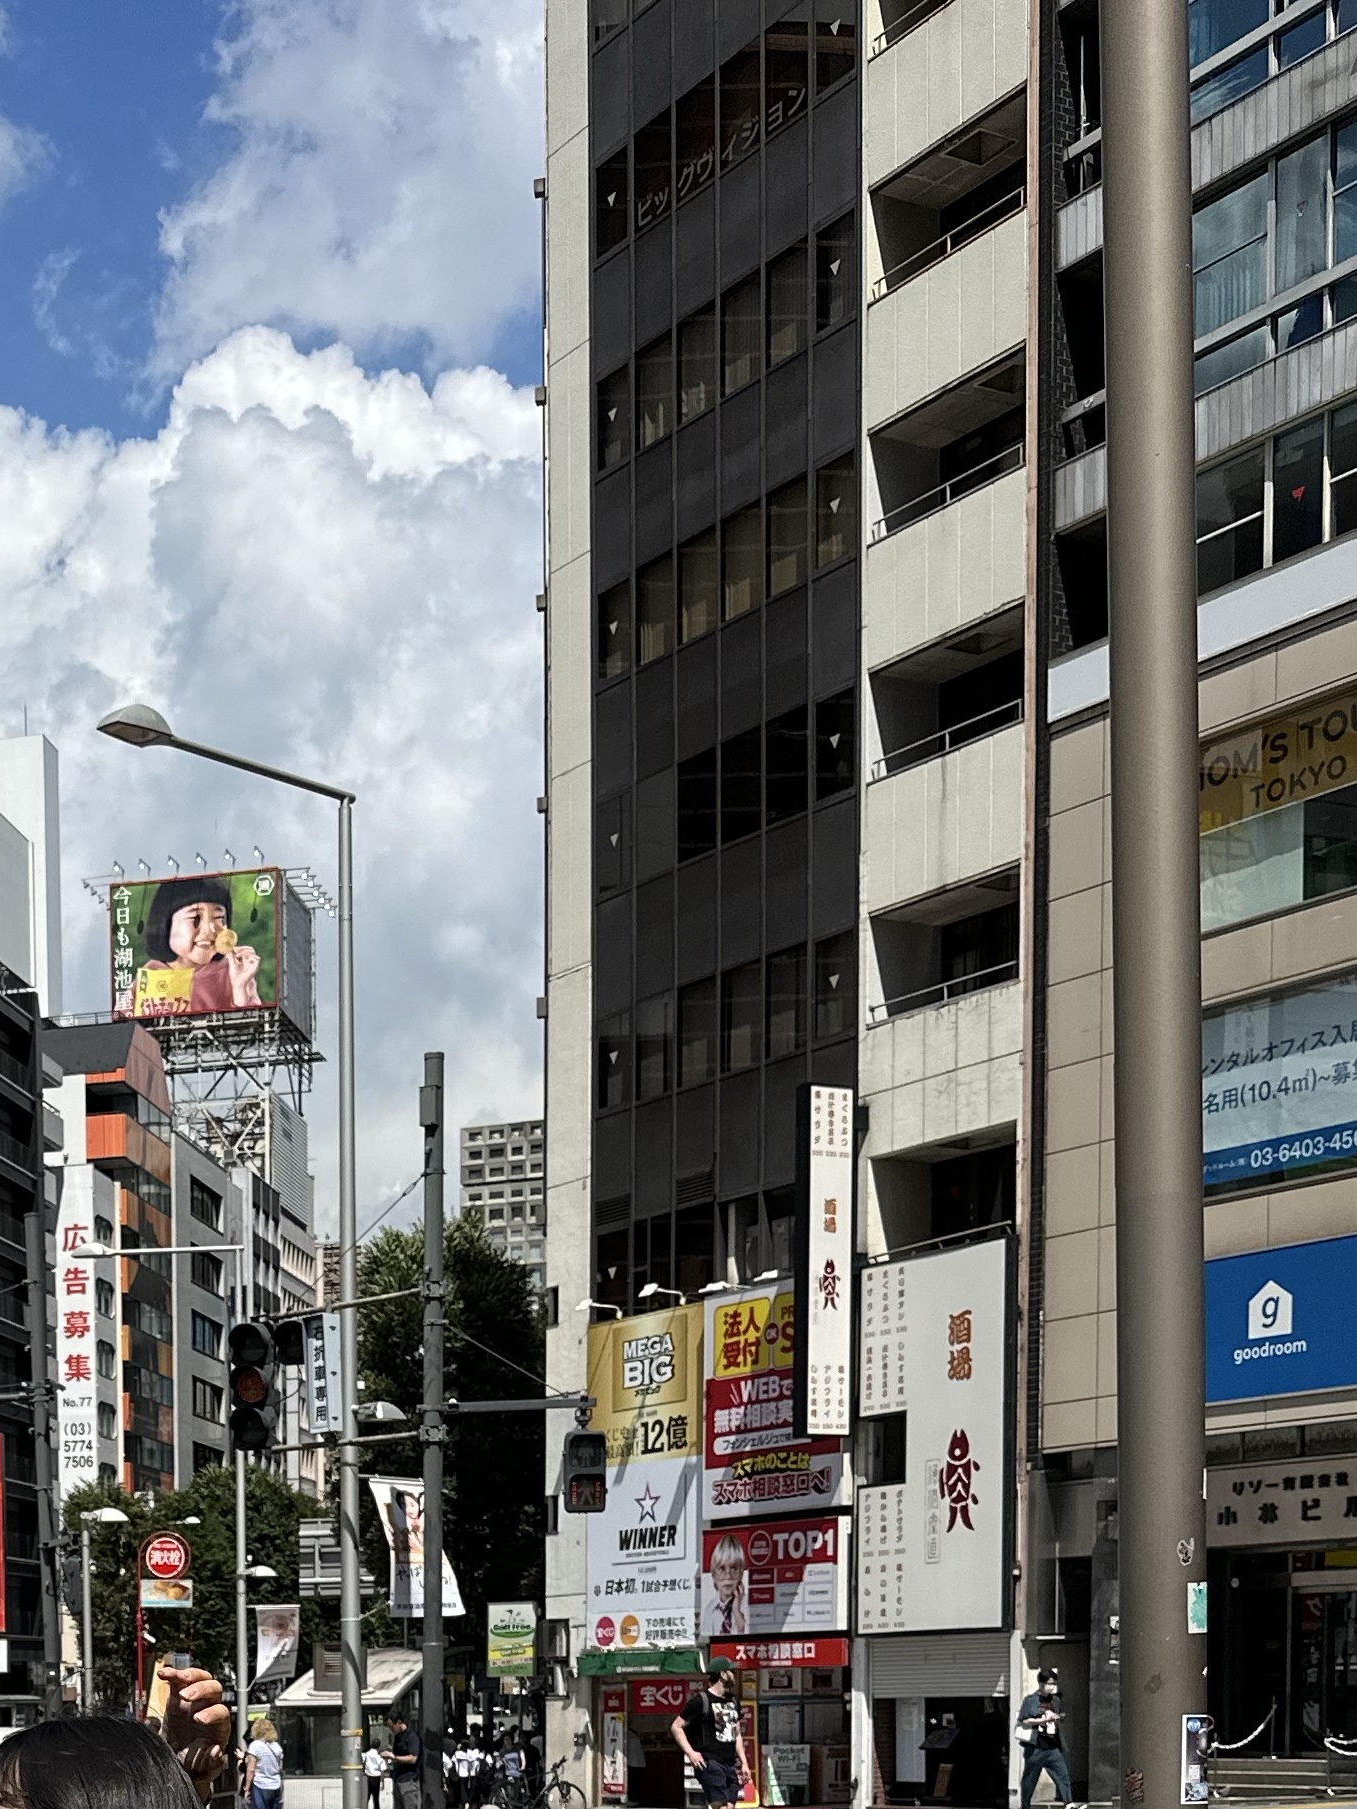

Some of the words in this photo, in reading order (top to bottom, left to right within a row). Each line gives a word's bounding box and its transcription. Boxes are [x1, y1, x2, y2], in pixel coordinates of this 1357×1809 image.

[1250, 755, 1347, 809] TOKYO
[63, 1224, 92, 1382] 広告募集
[723, 1306, 762, 1341] 法人
[622, 1331, 674, 1360] MEGA
[723, 1337, 762, 1371] 受付
[947, 1309, 972, 1382] 酒場
[1234, 1339, 1307, 1365] goodroom
[623, 1355, 675, 1390] BIG
[62, 1397, 93, 1408] No.77
[63, 1421, 92, 1436] (03)
[641, 1415, 688, 1456] 12億
[64, 1440, 93, 1453] 5774
[64, 1456, 93, 1469] 7506
[732, 1452, 811, 1478] スマホのことは
[619, 1524, 677, 1551] WINNER
[773, 1528, 834, 1560] TOP1
[150, 1549, 181, 1566] 消火栓
[735, 1642, 816, 1661] スマホ相談窓口
[639, 1685, 683, 1707] 宝くじ
